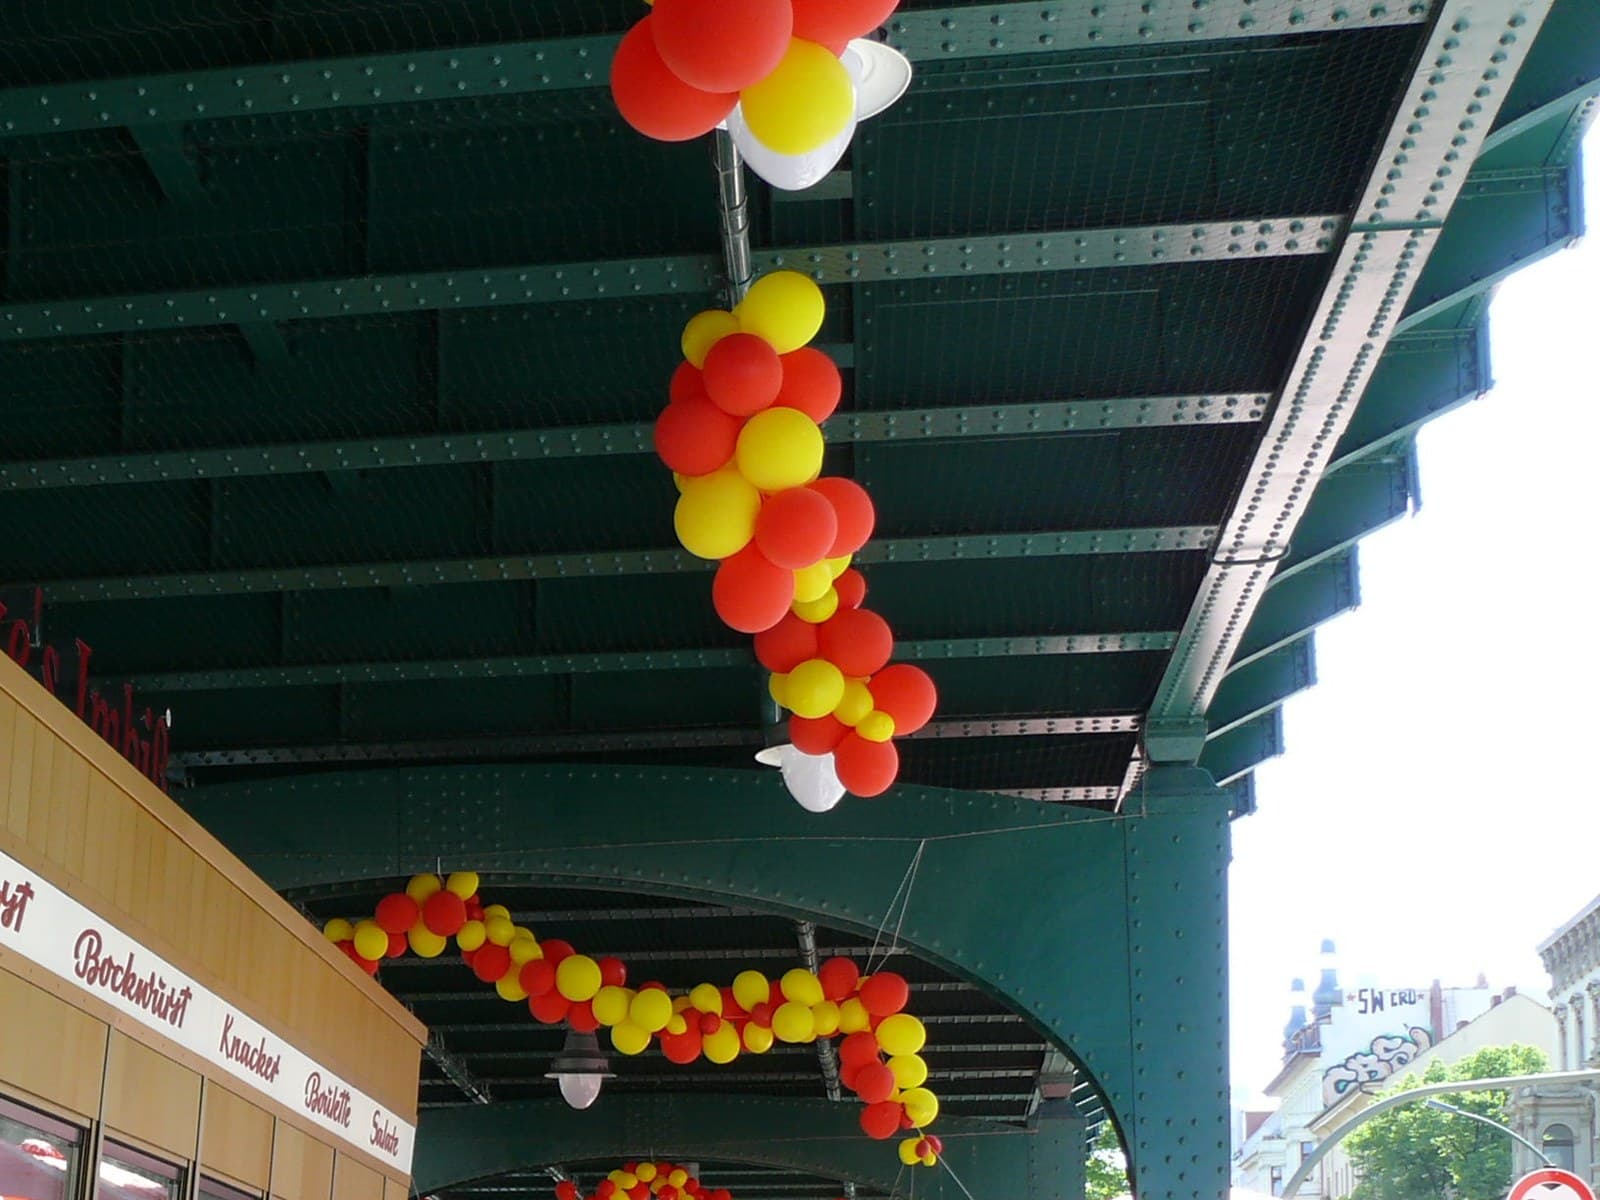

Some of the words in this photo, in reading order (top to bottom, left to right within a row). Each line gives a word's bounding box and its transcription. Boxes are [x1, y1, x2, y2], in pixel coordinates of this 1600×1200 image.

[74, 928, 192, 1028] Bockwurst
[1358, 988, 1384, 1014] SW
[219, 1013, 281, 1084] Knacker
[370, 1109, 399, 1157] Salate
